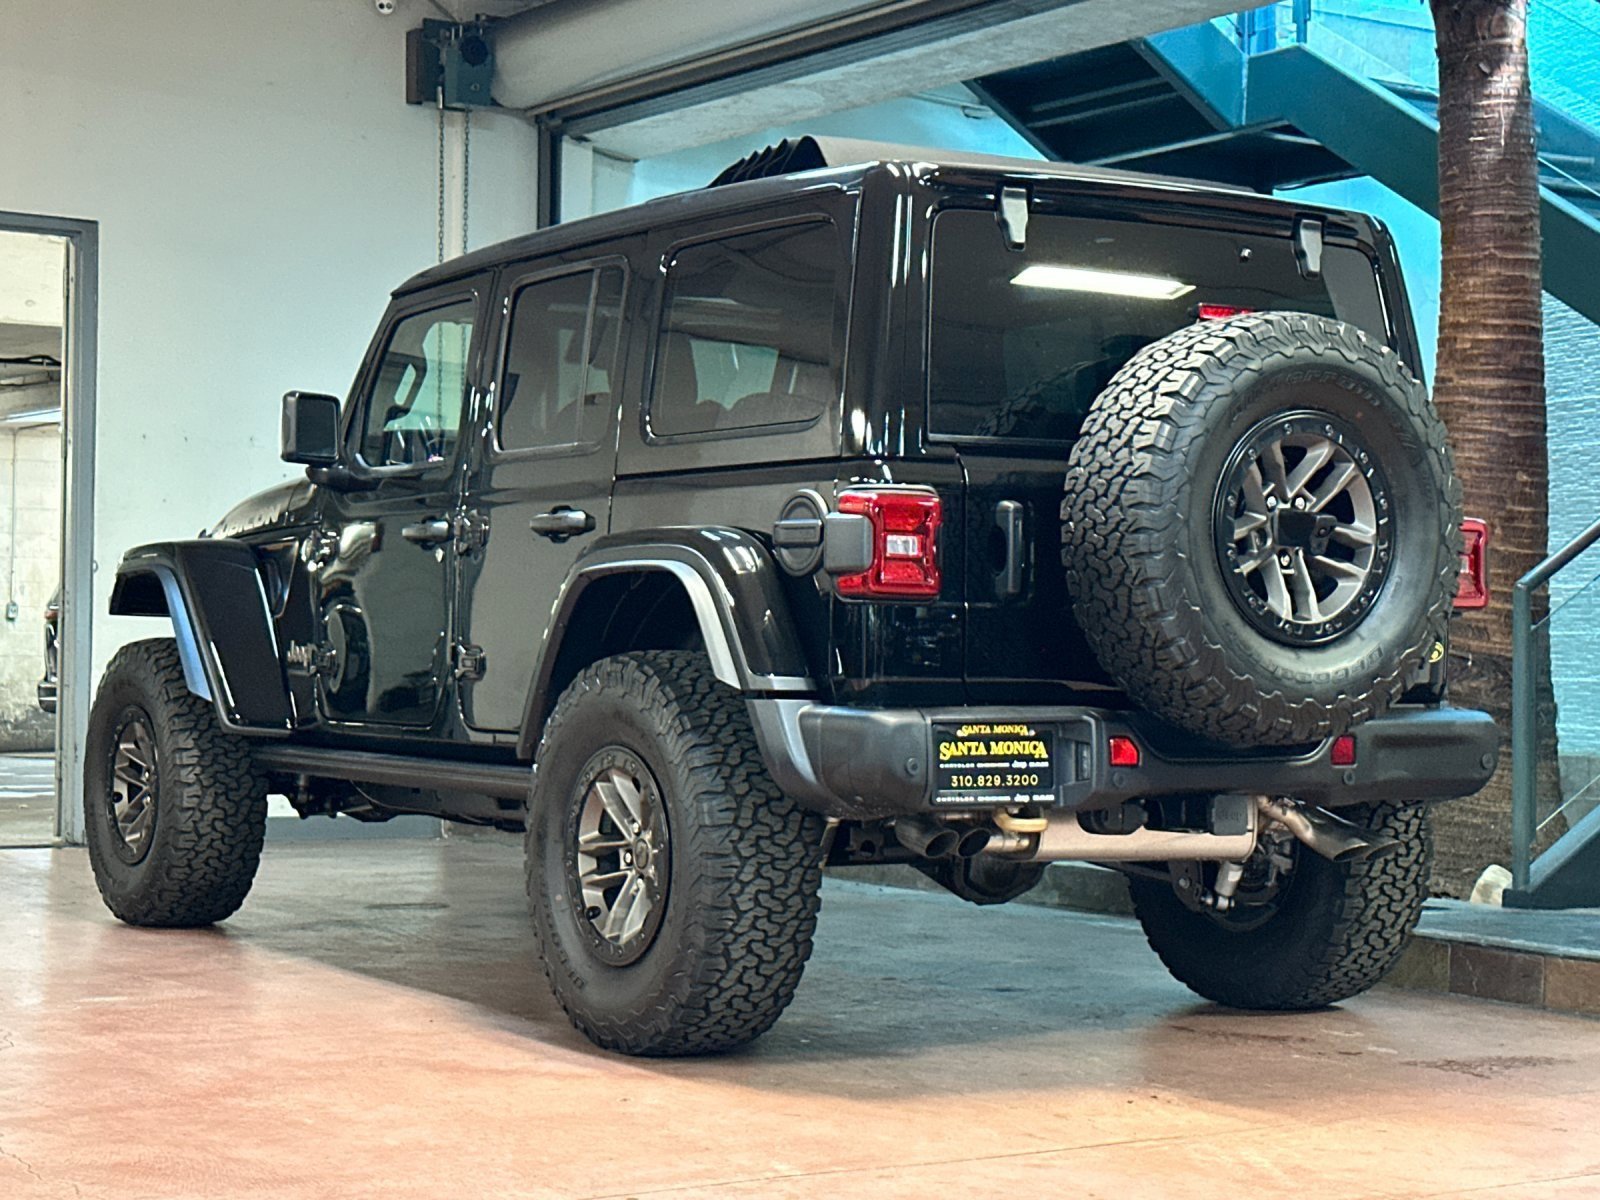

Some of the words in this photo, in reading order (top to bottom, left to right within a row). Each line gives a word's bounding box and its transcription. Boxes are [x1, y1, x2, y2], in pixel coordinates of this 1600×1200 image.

[961, 725, 991, 736] SANTA
[993, 724, 1029, 736] MONICA
[940, 742, 987, 760] SANTA
[990, 741, 1048, 759] MONICA
[951, 774, 1039, 788] 310.829.3200
